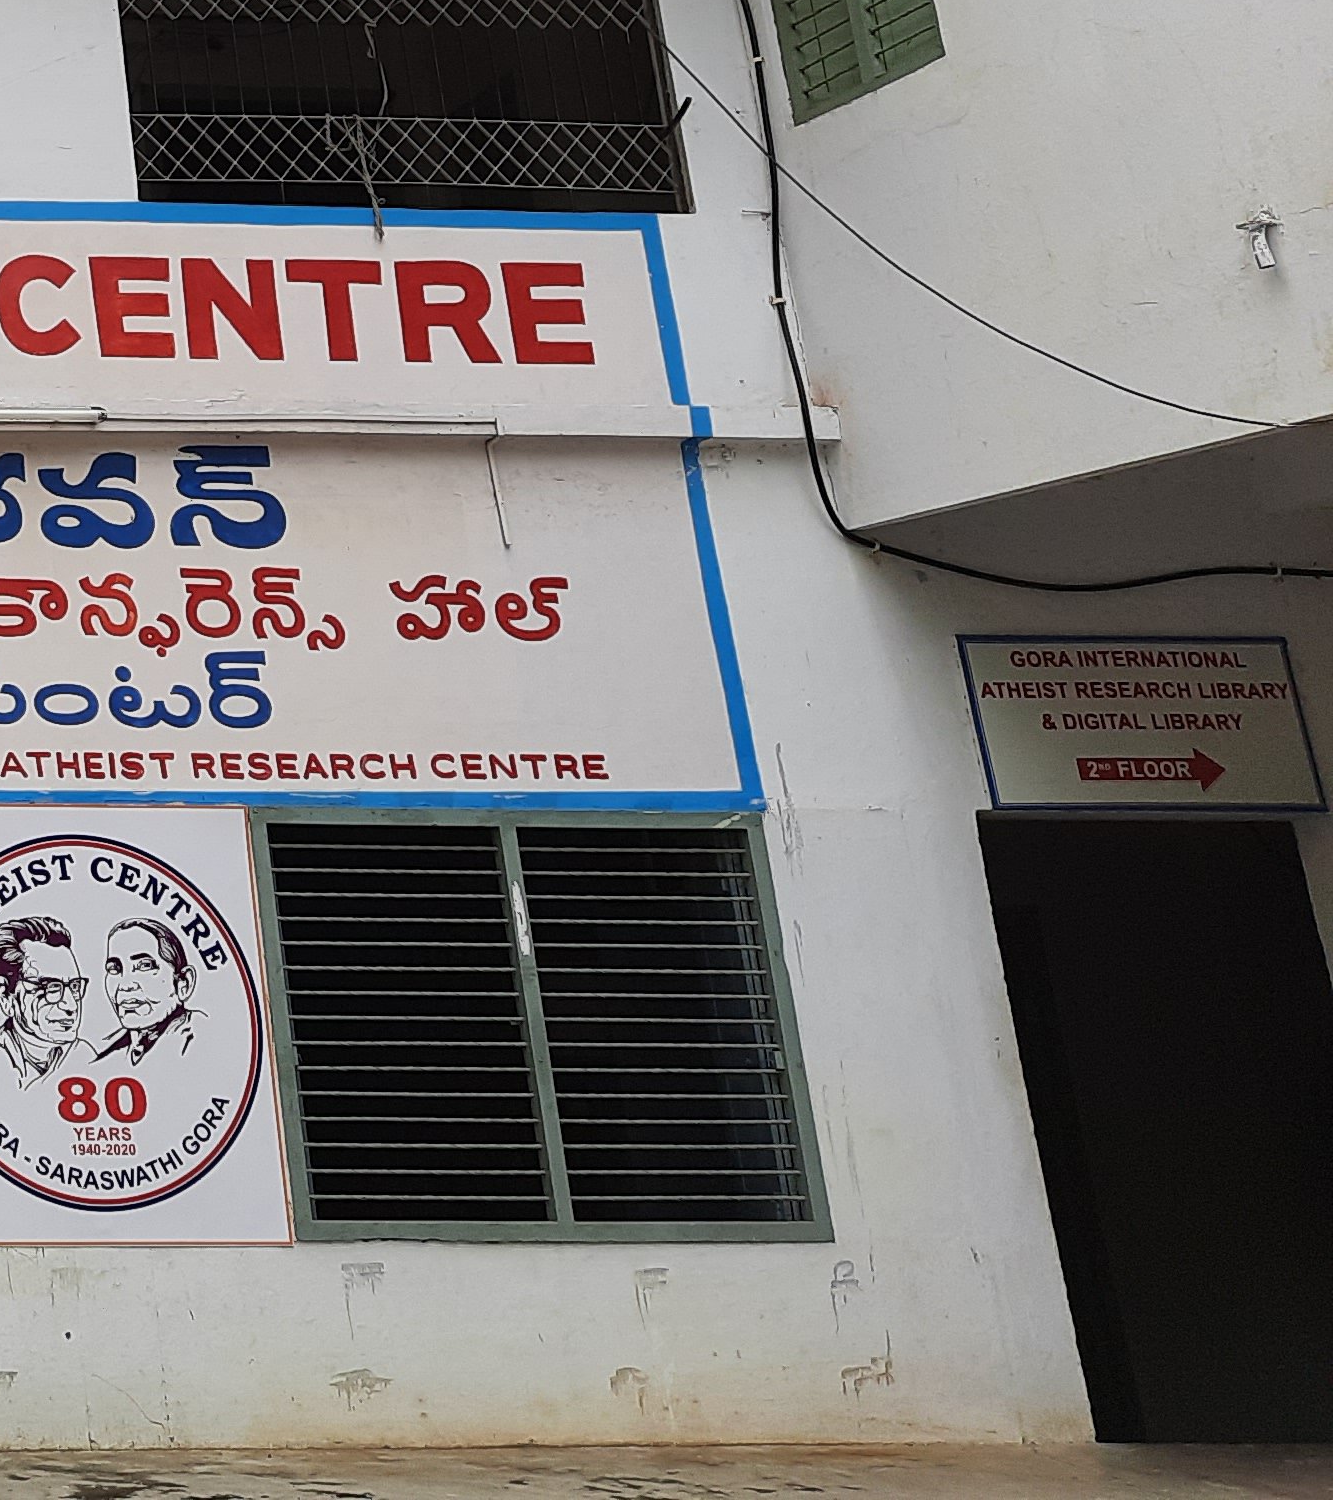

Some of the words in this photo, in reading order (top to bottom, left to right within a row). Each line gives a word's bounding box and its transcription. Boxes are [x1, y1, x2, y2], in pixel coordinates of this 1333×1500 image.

[388, 573, 570, 642] హాల్
[1010, 650, 1073, 668] GORA
[1078, 651, 1247, 668] INTERNATIONAL
[981, 682, 1068, 699] ATHEIST
[1074, 682, 1192, 699] RESEARCH
[1197, 682, 1290, 700] LIBRARY
[1042, 713, 1058, 731] &
[1062, 713, 1147, 731] DIGITAL
[1151, 714, 1243, 731] LIBRARY
[0, 751, 176, 781] ATHEIST
[191, 752, 419, 781] RESEARCH
[430, 753, 610, 781] CENTRE
[1117, 760, 1193, 779] FLOOR
[89, 856, 228, 972] CENTRE
[57, 1076, 148, 1125] 80
[35, 1148, 184, 1191] SARASWATHI
[181, 1096, 231, 1156] GORA
[74, 1126, 132, 1142] YEARS
[71, 1143, 136, 1156] 1940-2020
